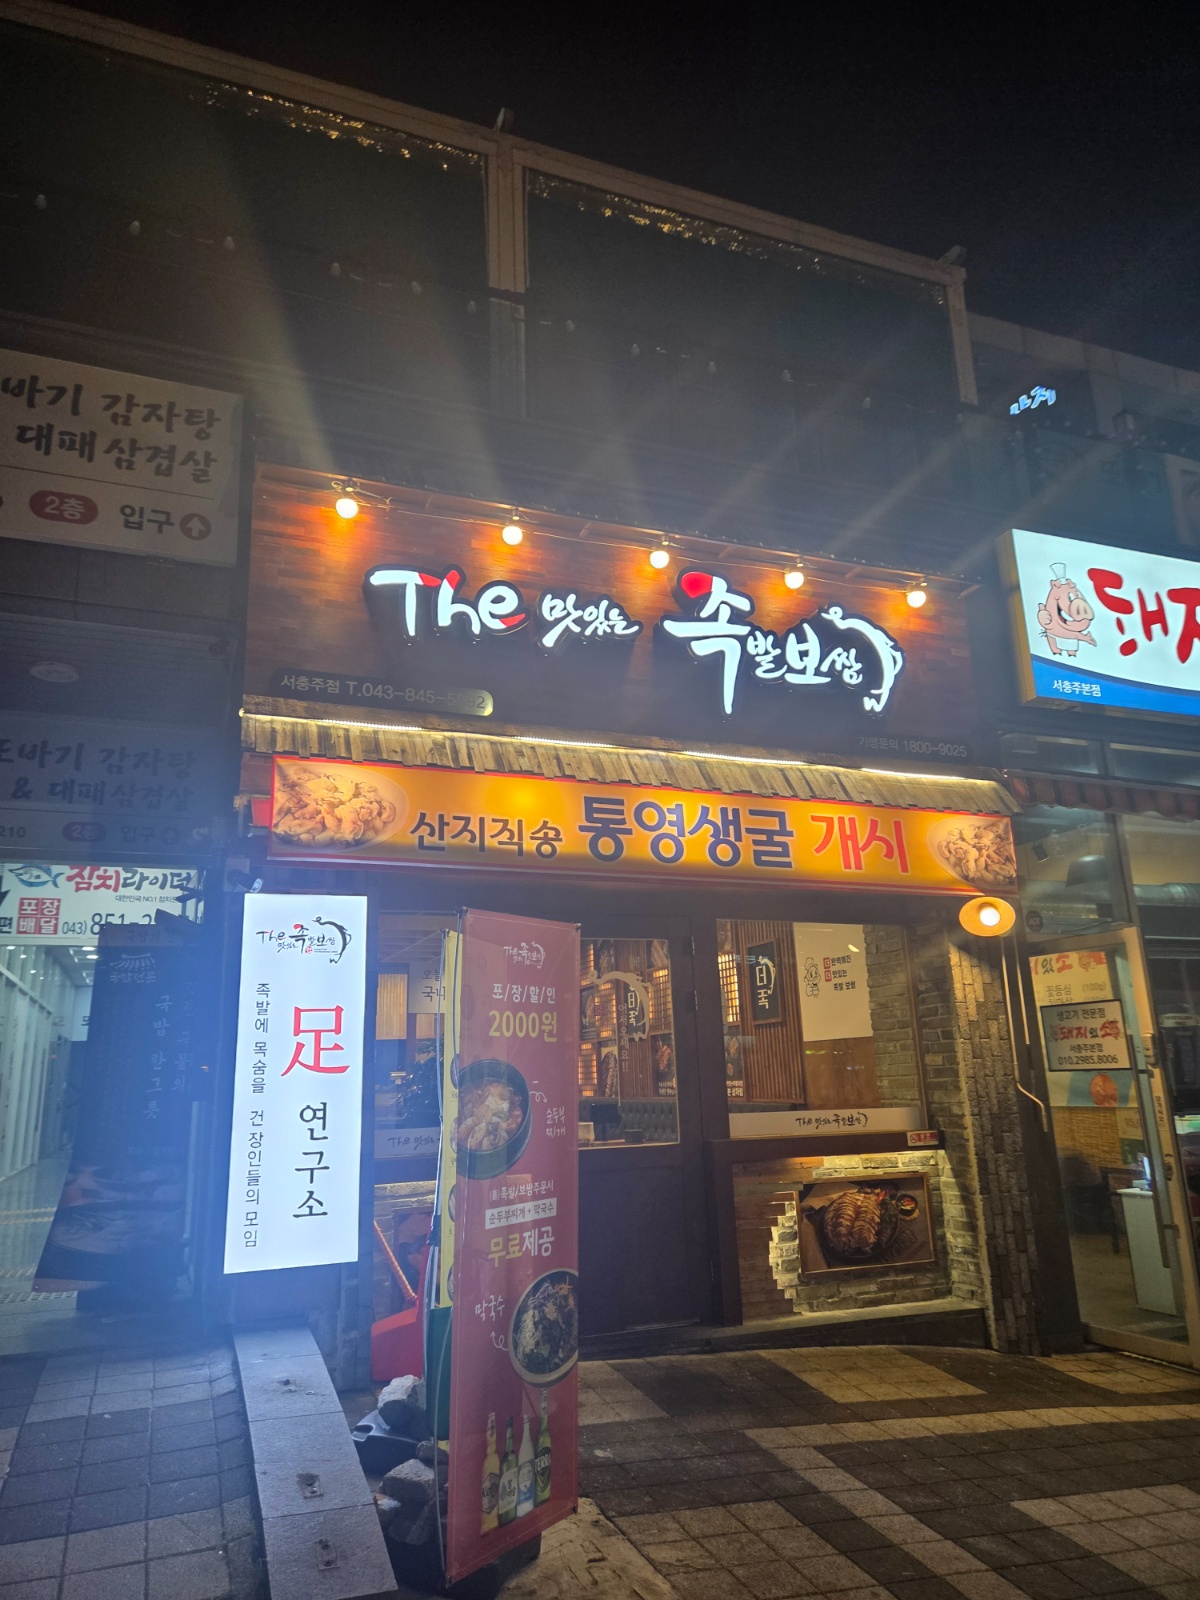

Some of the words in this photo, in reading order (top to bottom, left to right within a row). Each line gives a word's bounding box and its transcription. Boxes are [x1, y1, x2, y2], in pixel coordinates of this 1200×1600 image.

[101, 393, 221, 441] 감자탕
[16, 423, 218, 484] 대패삼겹살
[44, 495, 84, 520] 2층
[119, 504, 175, 533] 입구
[369, 569, 527, 637] The
[541, 593, 640, 648] 맛있는
[280, 673, 340, 694] 서충주점
[1053, 680, 1101, 697] 서충주본점
[857, 736, 898, 751] 가맹문의
[903, 740, 967, 758] 1800-9025
[99, 746, 197, 780] 감자탕
[10, 777, 33, 800] &
[48, 778, 193, 812] 대패삼겹살
[119, 826, 155, 844] 입구
[409, 812, 563, 859] 산지직송
[578, 796, 794, 868] 통영생굴
[810, 815, 909, 873] 개시
[20, 899, 60, 916] 포장
[19, 918, 57, 934] 배달
[62, 920, 87, 936] 043)
[255, 929, 287, 944] The
[492, 983, 556, 1004] 포/장/할/인
[154, 995, 173, 1037] 국밥
[254, 983, 271, 1033] 족발에
[1056, 1010, 1080, 1022] 생고기
[1082, 1007, 1106, 1020] 전문점
[488, 1010, 557, 1042] 2000원
[280, 1005, 351, 1077] 足
[1069, 1043, 1103, 1054] 서충주본점
[251, 1041, 268, 1094] 목숨을
[1057, 1053, 1118, 1066] 010.2985.8006
[546, 1106, 566, 1124] 순두부
[796, 1116, 813, 1128] The
[387, 1136, 411, 1149] The
[546, 1127, 566, 1139] 찌개
[292, 1101, 330, 1219] 연구소
[489, 1206, 526, 1225] 순두부찌개
[533, 1202, 554, 1216] 막국수
[243, 1211, 259, 1248] 모임
[488, 1226, 555, 1268] 무료제공
[474, 1294, 506, 1322] 막국수
